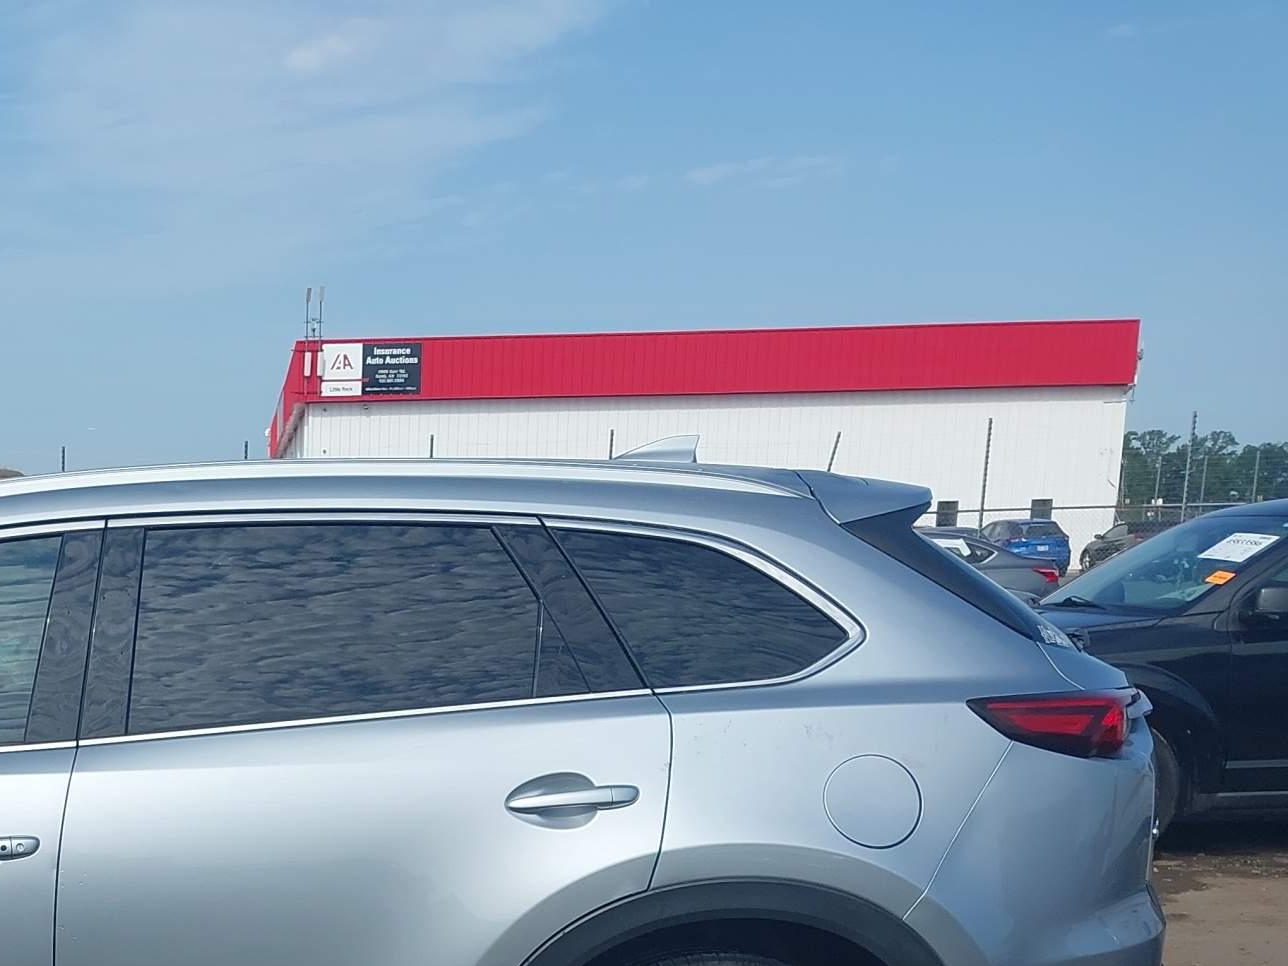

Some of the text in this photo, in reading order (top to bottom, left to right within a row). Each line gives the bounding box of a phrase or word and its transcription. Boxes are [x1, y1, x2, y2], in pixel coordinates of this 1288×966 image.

[373, 347, 411, 355] Insurance
[366, 355, 419, 365] Auto Auctions
